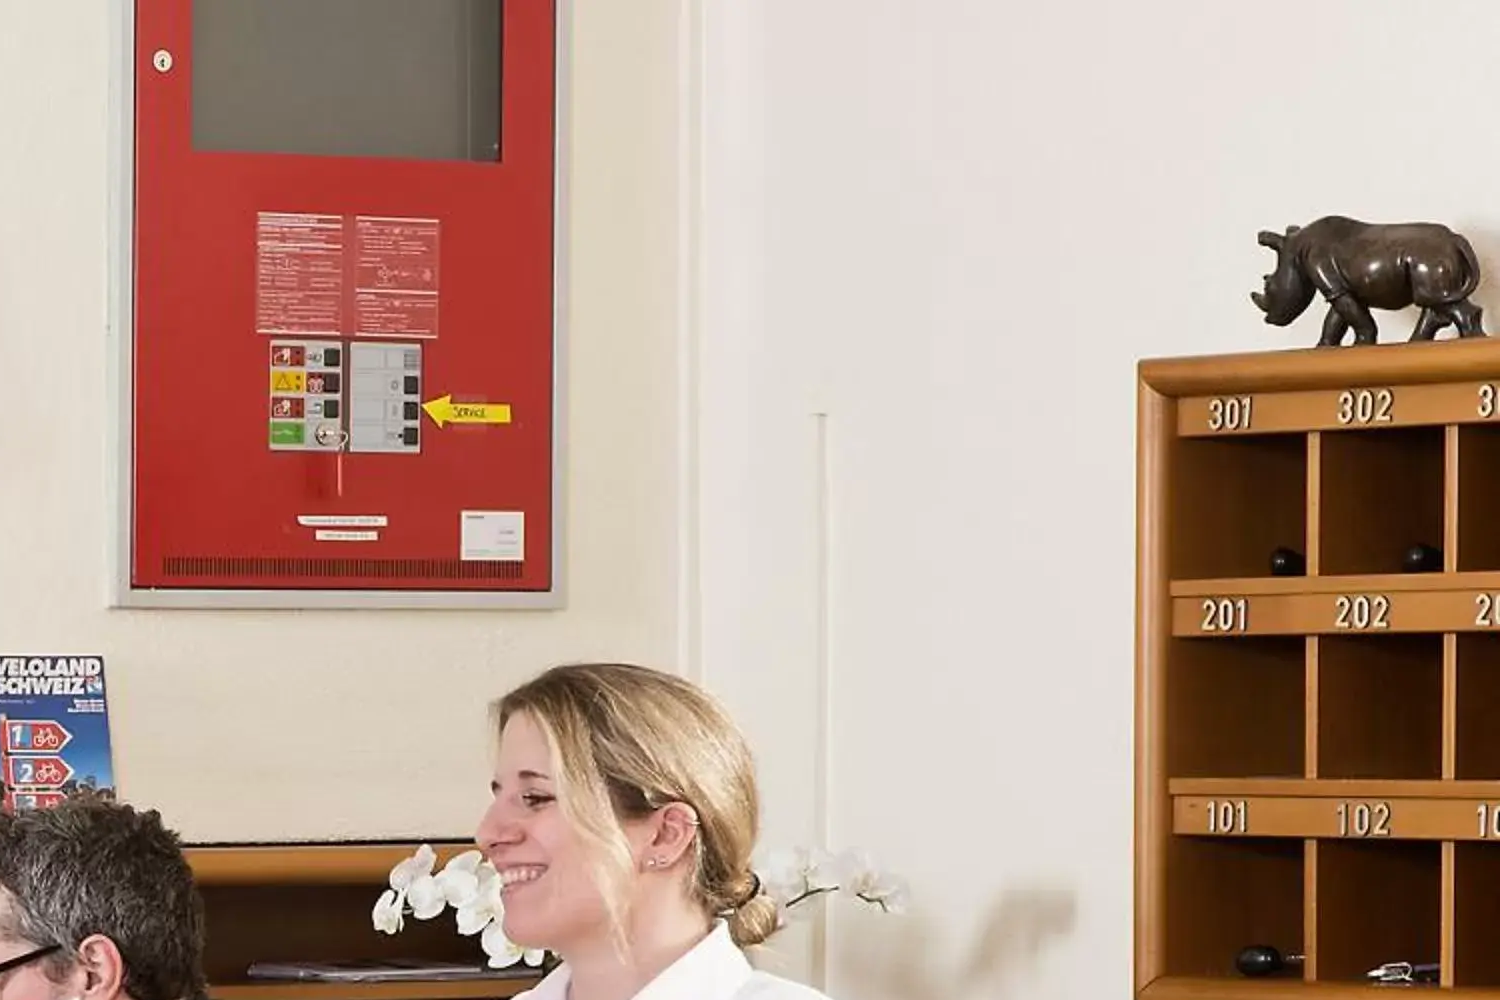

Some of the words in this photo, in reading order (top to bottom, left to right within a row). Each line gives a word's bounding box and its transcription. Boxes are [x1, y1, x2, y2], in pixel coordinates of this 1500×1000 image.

[1207, 395, 1253, 431] 301
[1337, 388, 1394, 424] 302
[1201, 598, 1249, 632] 201
[1334, 595, 1390, 629] 202
[11, 725, 23, 747] 1
[19, 763, 35, 783] 2
[1206, 800, 1249, 833] 101
[1336, 801, 1391, 837] 102
